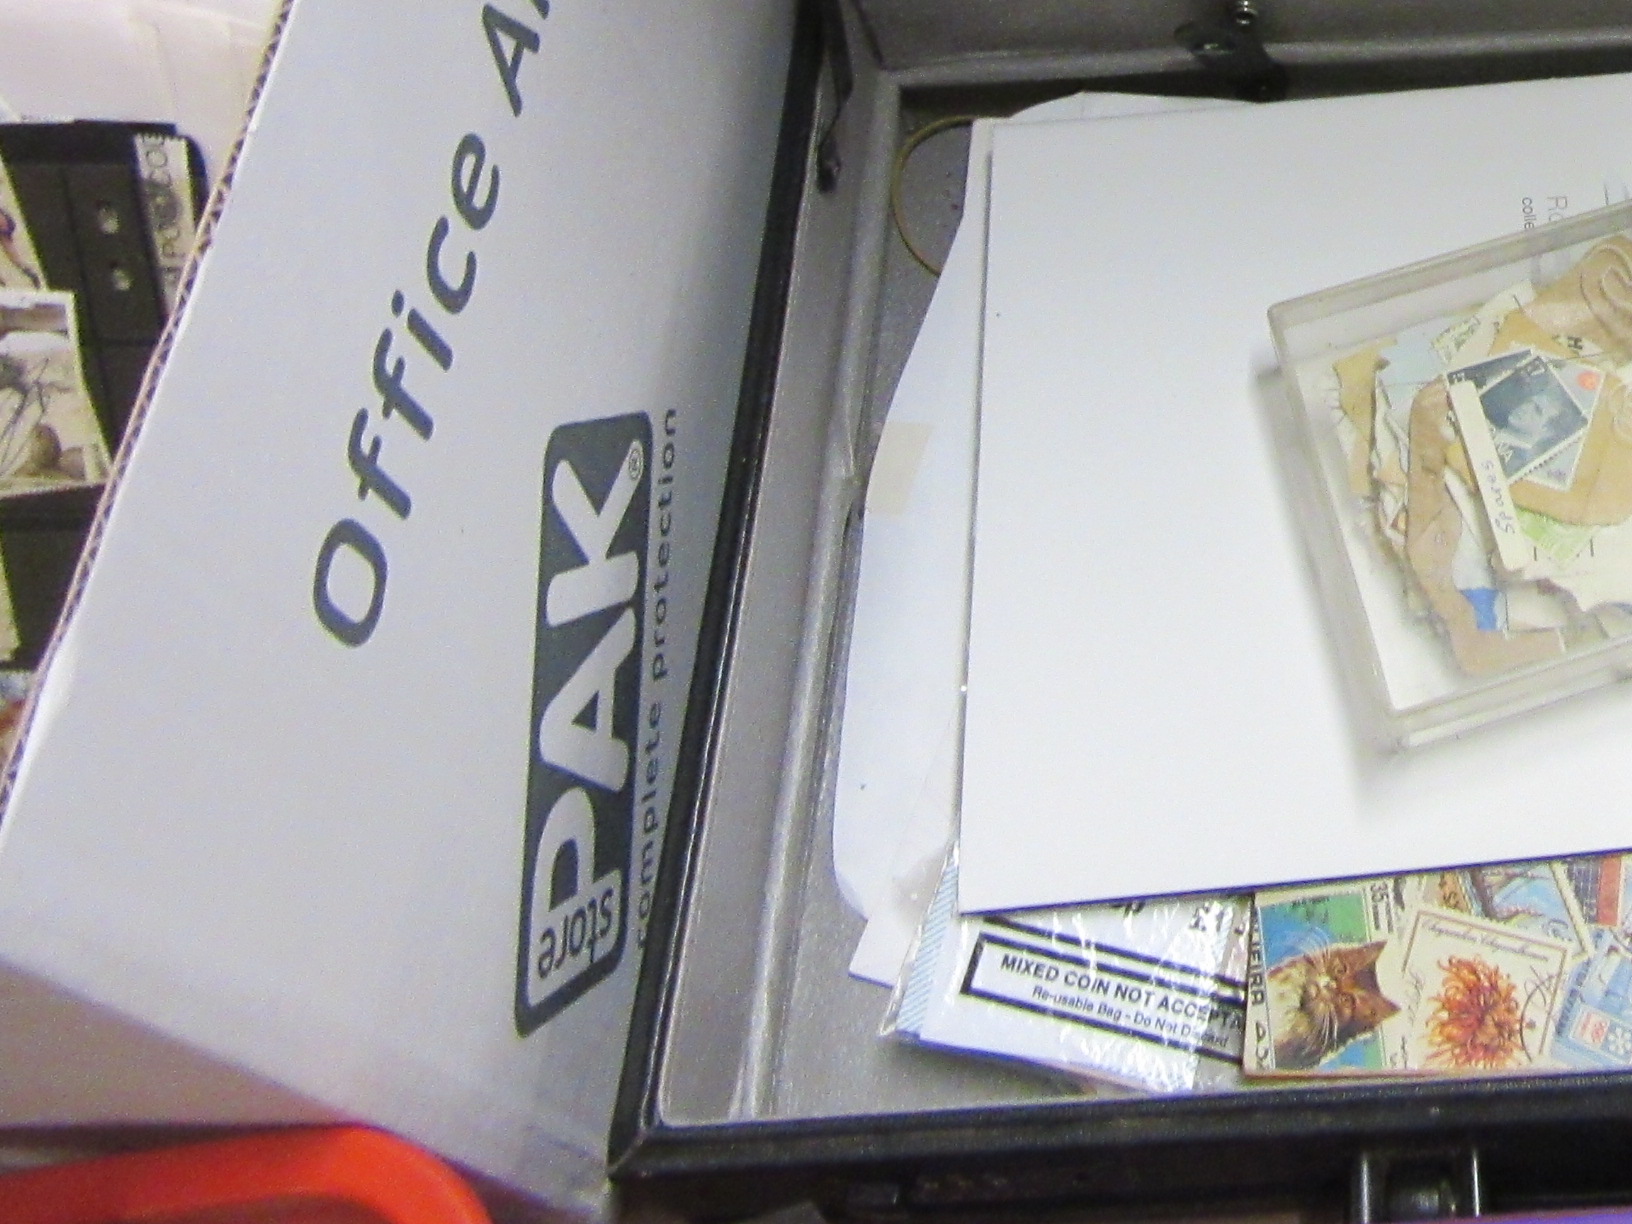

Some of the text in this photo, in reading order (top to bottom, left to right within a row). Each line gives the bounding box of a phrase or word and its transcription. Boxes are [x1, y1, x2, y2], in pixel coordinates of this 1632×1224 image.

[312, 134, 502, 648] Office
[650, 407, 678, 682] protection
[535, 440, 645, 912] PAK
[537, 874, 618, 984] store
[1000, 952, 1060, 982] MIXED
[1063, 968, 1111, 998] COIN
[1114, 981, 1154, 1007] NOT
[1098, 1002, 1122, 1022] Bag
[1134, 1009, 1150, 1026] Do
